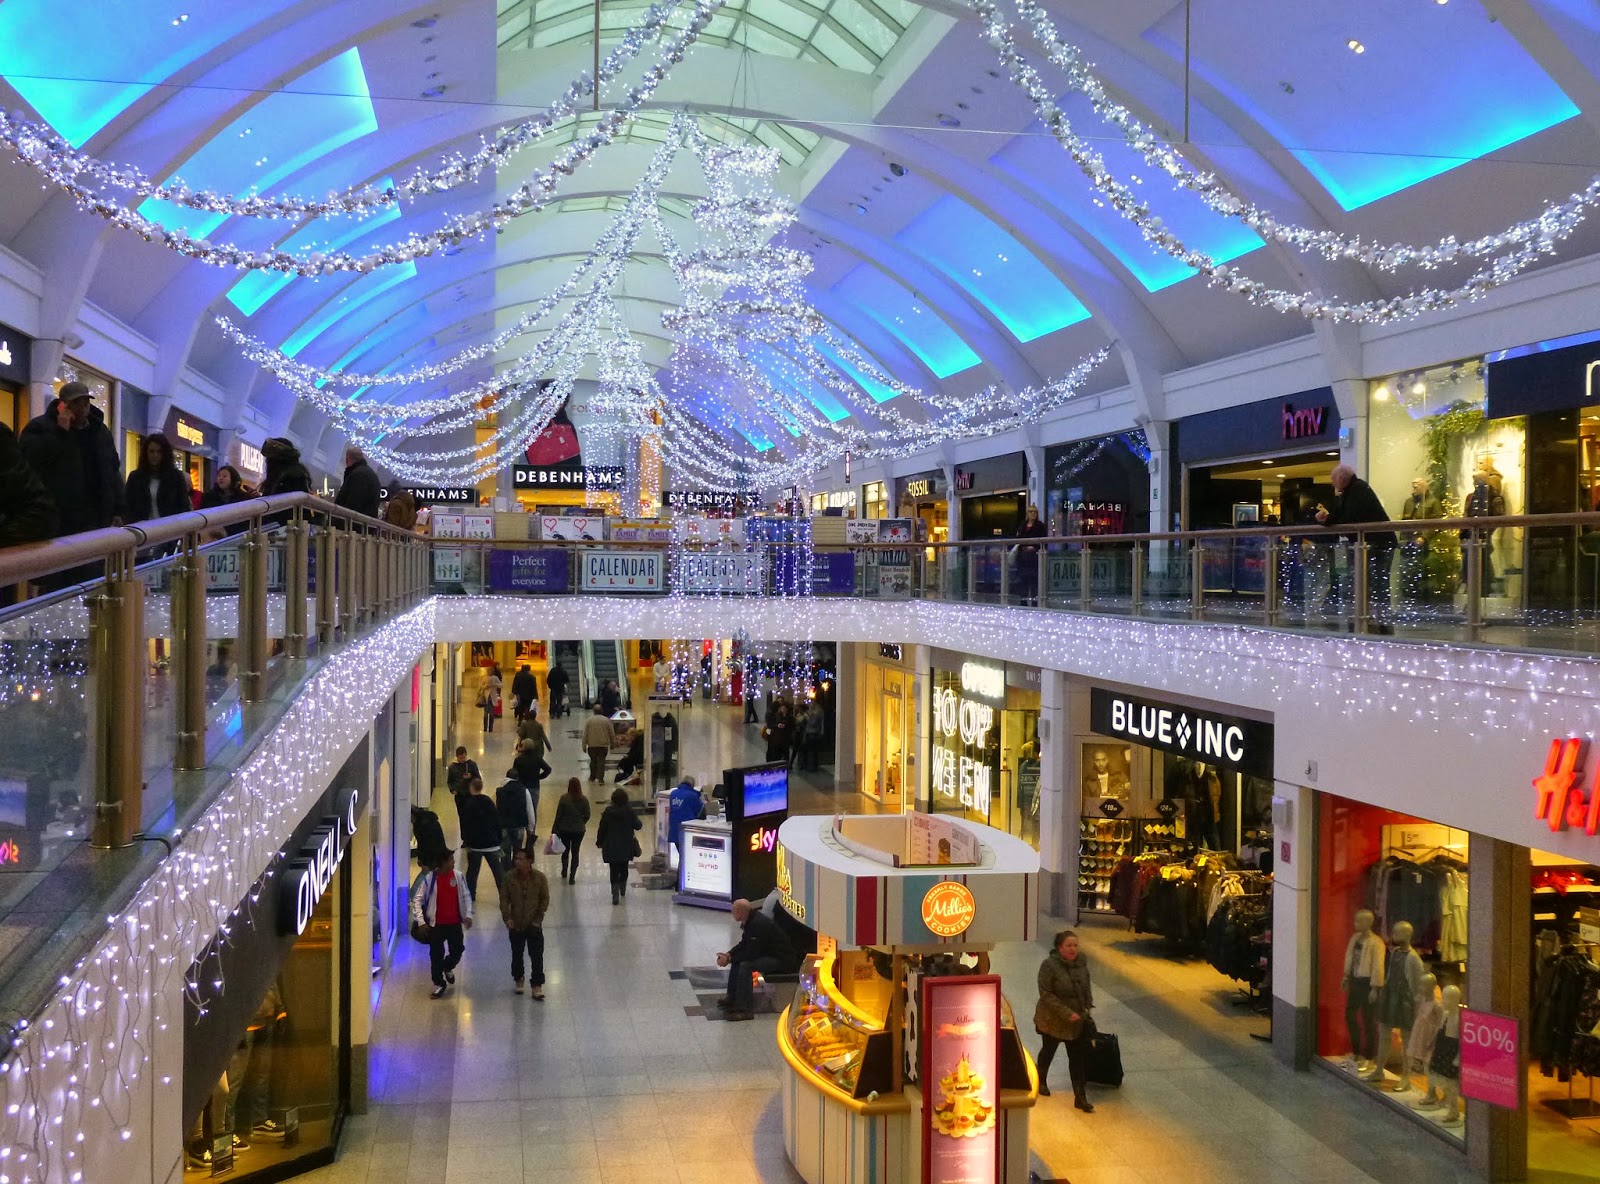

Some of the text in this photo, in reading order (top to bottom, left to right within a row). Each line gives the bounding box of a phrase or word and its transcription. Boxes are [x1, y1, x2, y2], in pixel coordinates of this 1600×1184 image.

[1282, 402, 1322, 439] hmv
[516, 470, 622, 483] DEBENHAMS
[908, 480, 928, 496] FOSSIL
[669, 494, 753, 503] DEBENHAS
[512, 555, 546, 565] Perfect
[591, 557, 654, 576] CALENDAR
[688, 558, 752, 577] CALENDR
[535, 566, 546, 576] for
[1112, 699, 1243, 762] BLUE INC
[672, 797, 684, 806] sky
[751, 827, 776, 852] sky
[926, 897, 972, 921] Millie's
[931, 915, 970, 933] COOKIES
[1463, 1022, 1515, 1053] 50%
